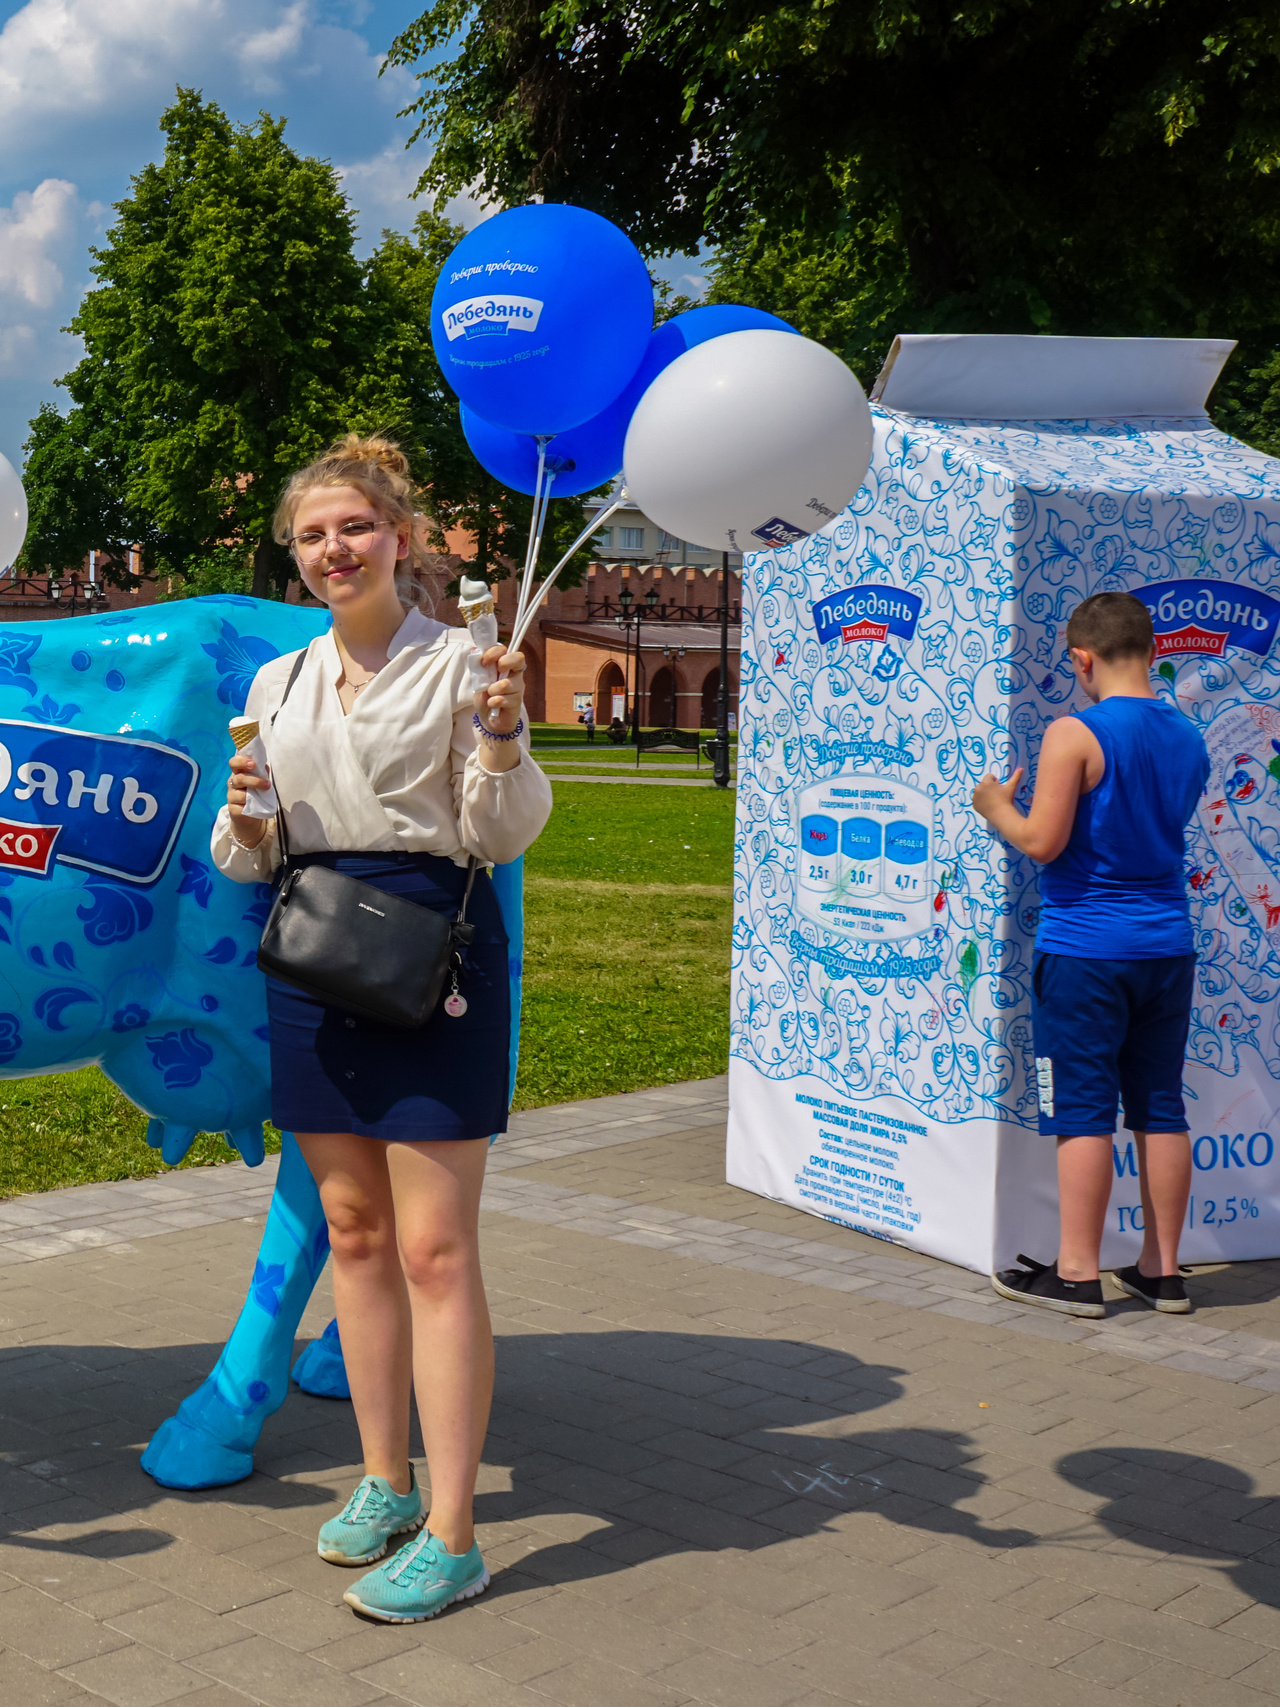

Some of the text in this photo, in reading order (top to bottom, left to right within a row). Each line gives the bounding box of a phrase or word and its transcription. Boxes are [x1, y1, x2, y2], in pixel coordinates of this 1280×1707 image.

[449, 259, 539, 285] Доверие проверено
[448, 301, 534, 330] Лебедянь
[513, 350, 531, 362] 1925
[532, 345, 550, 357] года
[820, 592, 912, 629] Лебедянь
[1144, 589, 1269, 631] ебедянь
[820, 740, 914, 765] Доверие проверено
[830, 788, 895, 800] ПИЩЕВАЯ ЦЕННОСТЬ:
[860, 801, 871, 811] 100
[851, 833, 871, 844] Белка
[809, 865, 823, 880] 2,5
[850, 869, 865, 886] 3,0
[895, 874, 910, 891] 4,7
[820, 903, 906, 922] ЭНЕРГЕТИЧЕСКАЯ ЦЕННОСТЬ
[791, 932, 818, 957] Верны
[821, 953, 879, 976] традициям
[889, 959, 912, 976] 1925
[914, 956, 938, 977] года
[1035, 1056, 1054, 1118] SURF
[795, 1092, 928, 1137] МОЛОКО ПИТЬЕВОЕ ПАСТЕРИЗОВАННОЕ
[813, 1110, 907, 1145] МАССОВАЯ ДОЛЯ ЖИРА 2,5%
[819, 1128, 843, 1144] Состав:
[845, 1138, 871, 1151] цельное
[821, 1142, 868, 1162] обезжиренное
[1113, 1132, 1274, 1178] МОКО
[794, 1173, 809, 1186] Дата
[810, 1180, 855, 1201] производства:
[803, 1165, 828, 1181] Хранить
[829, 1175, 840, 1185] при
[842, 1179, 884, 1199] температуре
[810, 1155, 829, 1169] СРОК
[831, 1161, 870, 1181] ГОДНОСТИ
[879, 1175, 904, 1193] СУТОК
[800, 1188, 828, 1204] смотрите
[834, 1199, 859, 1215] верхней
[861, 1209, 880, 1220] части
[881, 1215, 914, 1232] упаковки
[1203, 1196, 1259, 1229] 2,5%
